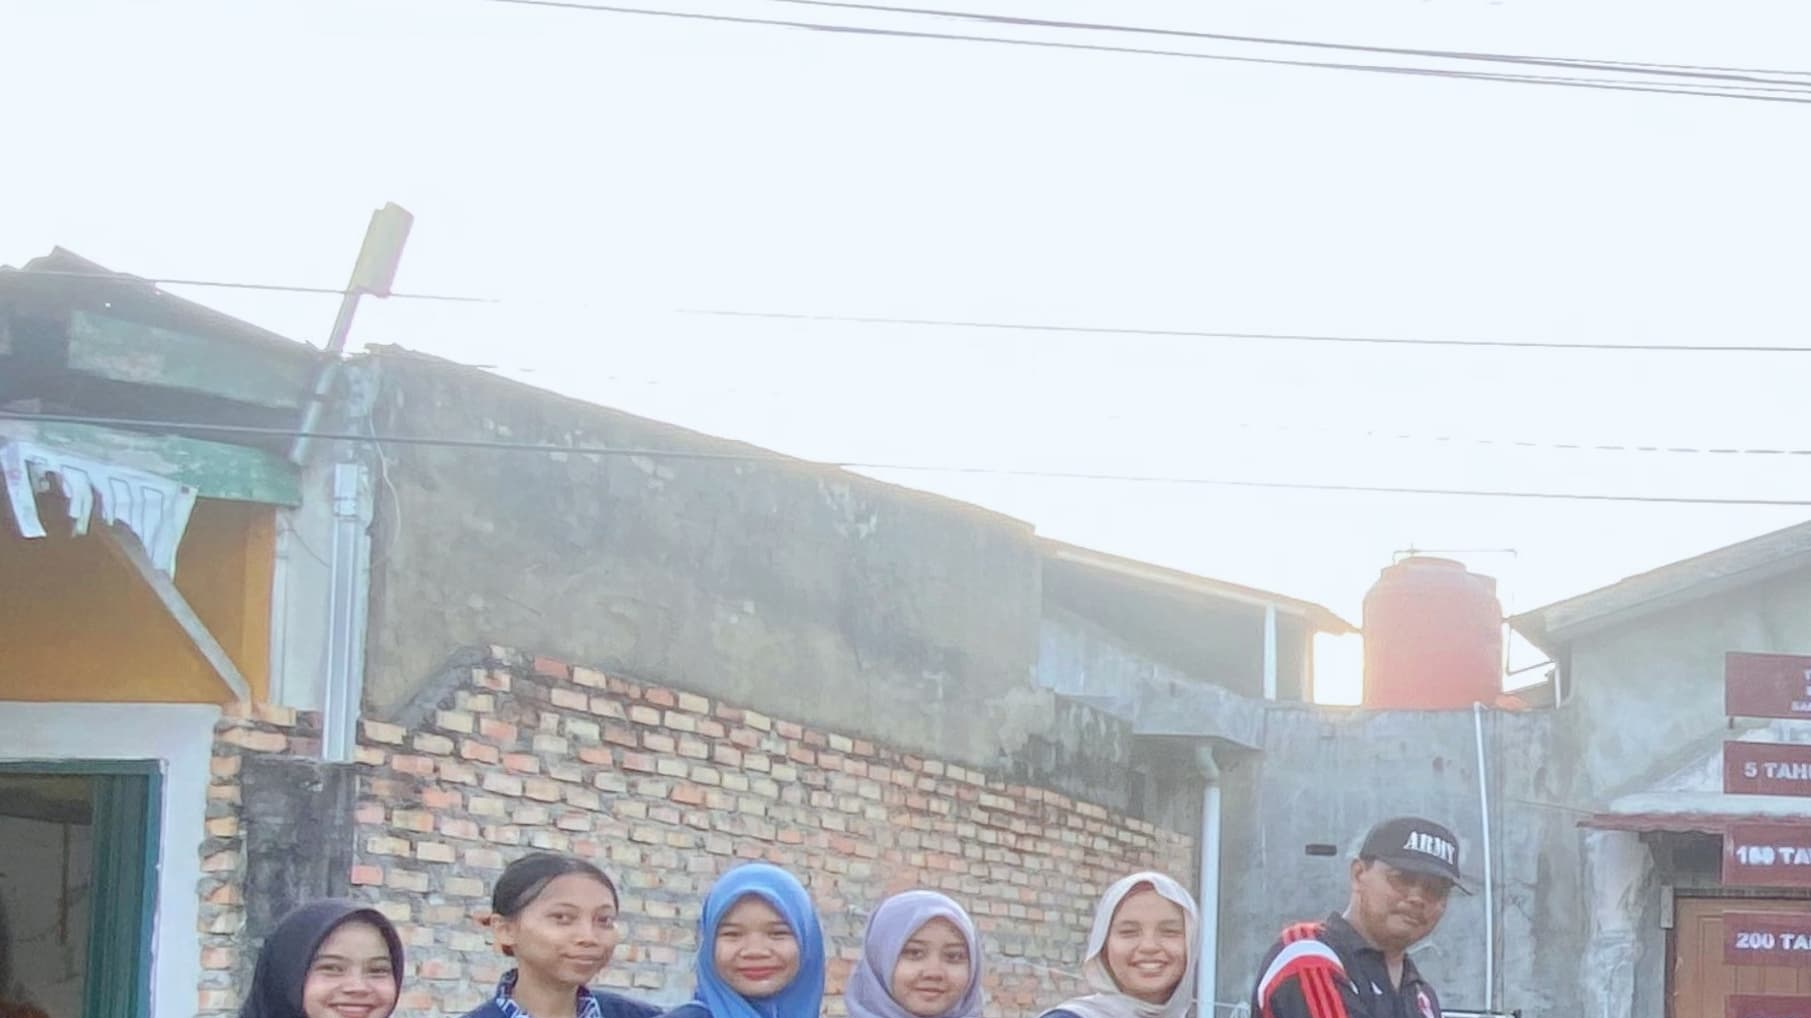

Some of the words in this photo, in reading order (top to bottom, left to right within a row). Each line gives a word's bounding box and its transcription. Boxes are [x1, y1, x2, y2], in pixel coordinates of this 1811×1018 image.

[1744, 762, 1758, 778] 5
[1403, 831, 1455, 865] ARMY
[1736, 932, 1775, 949] 200
